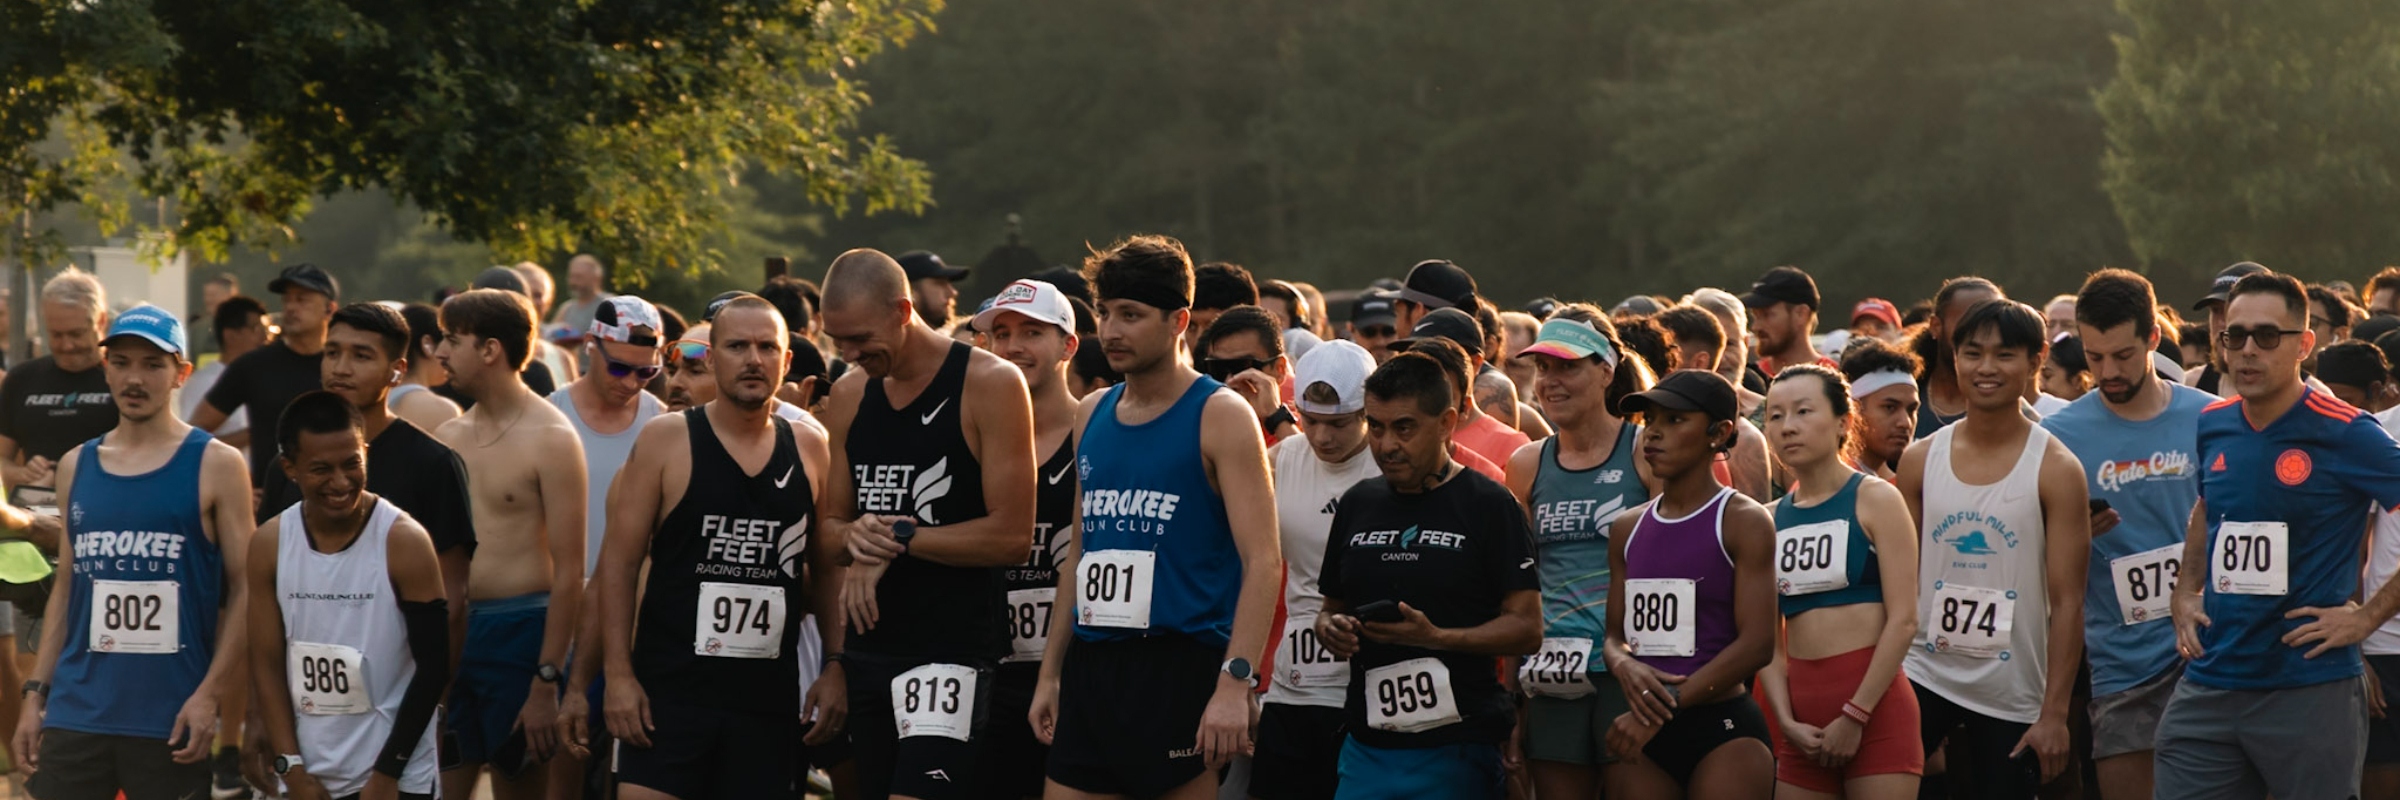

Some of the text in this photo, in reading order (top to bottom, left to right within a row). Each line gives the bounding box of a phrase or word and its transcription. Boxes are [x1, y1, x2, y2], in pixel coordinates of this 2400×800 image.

[1015, 286, 1033, 294] DAY
[25, 392, 111, 406] FLEET FEET
[2097, 450, 2189, 492] Gate City
[858, 488, 908, 511] FEET
[1081, 489, 1181, 521] HEROKEE
[1536, 500, 1597, 520] FLEET
[701, 514, 780, 542] FLEET
[1115, 519, 1165, 536] CLUB
[1350, 529, 1466, 549] FLEET FEET
[1540, 515, 1591, 535] FEET
[1568, 531, 1596, 541] TEAM
[1931, 511, 2019, 549] MINDFUL MILES
[74, 530, 186, 560] HEROKEE
[706, 538, 773, 565] FEET
[1381, 552, 1420, 562] CANTON
[1780, 533, 1833, 574] 850
[2223, 534, 2271, 573] 870
[72, 559, 176, 574] RUN CLUB
[695, 562, 778, 579] RACING TEAM
[1019, 569, 1053, 581] TEAM
[1968, 561, 1987, 570] CLUB
[2127, 557, 2181, 602] 873
[1085, 562, 1134, 603] 801
[104, 593, 162, 631] 802
[712, 596, 771, 636] 974
[1633, 592, 1678, 632] 880
[1941, 596, 1997, 638] 874
[1289, 627, 1348, 665] 102
[302, 655, 349, 695] 986
[1527, 651, 1584, 685] 1232
[904, 676, 961, 715] 813
[1378, 670, 1438, 718] 959
